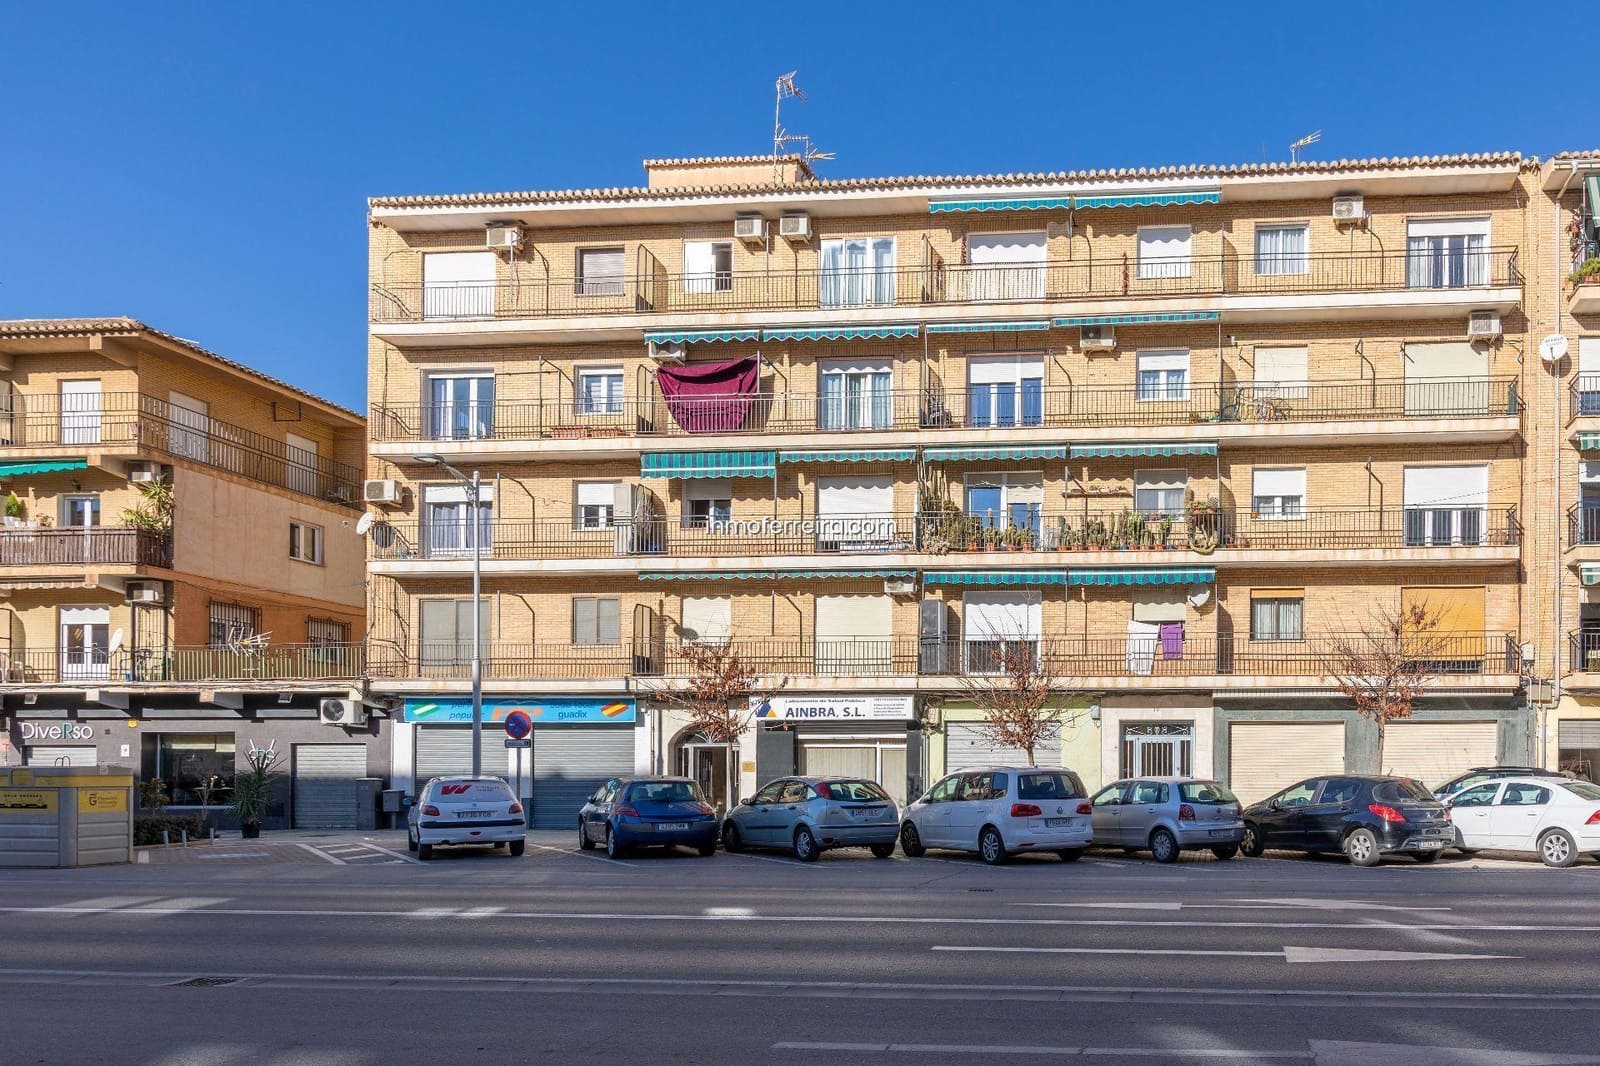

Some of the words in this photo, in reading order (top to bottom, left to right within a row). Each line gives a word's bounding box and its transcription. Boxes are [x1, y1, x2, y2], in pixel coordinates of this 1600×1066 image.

[449, 711, 485, 721] popur
[558, 710, 587, 720] guadix
[785, 707, 839, 718] AINBRA,
[843, 706, 866, 717] S.L.
[22, 722, 93, 739] DiveRso
